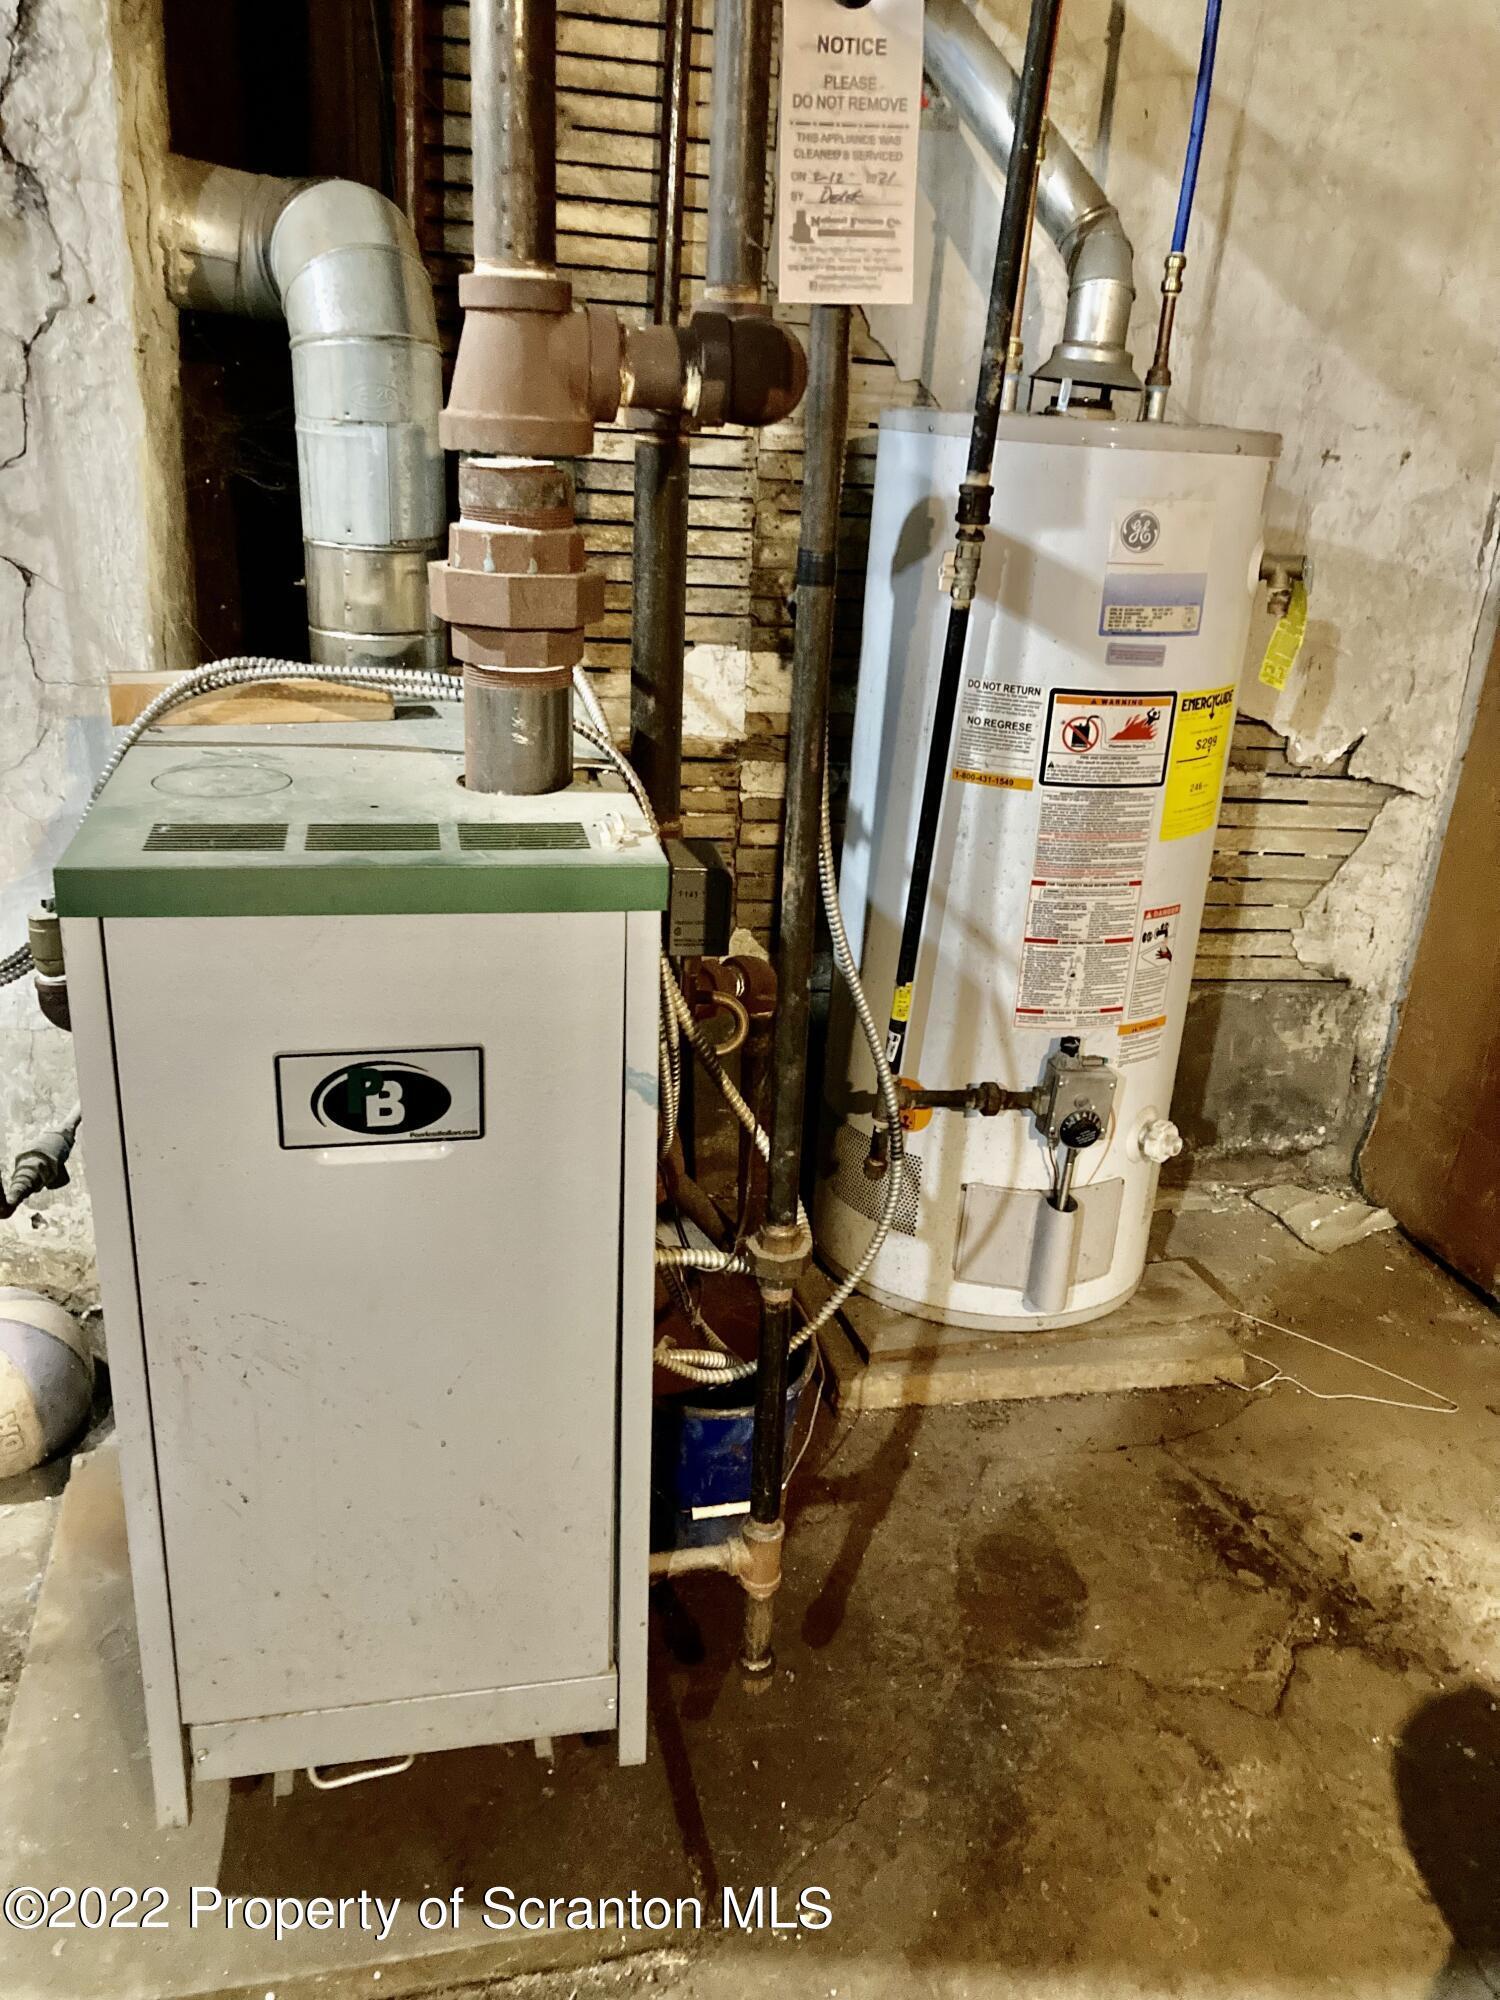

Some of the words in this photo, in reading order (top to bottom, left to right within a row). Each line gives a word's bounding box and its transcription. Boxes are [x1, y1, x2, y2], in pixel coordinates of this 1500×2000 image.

[817, 35, 887, 56] NOTICE
[823, 74, 878, 91] PLEASE
[792, 94, 813, 109] DO
[816, 95, 845, 110] NOT
[848, 96, 908, 112] REMOVE
[797, 132, 819, 143] THIS
[967, 679, 981, 689] DO
[983, 681, 1002, 692] NOT
[1003, 683, 1042, 696] RETURN
[1101, 698, 1143, 706] WARNING
[966, 715, 982, 726] NO
[983, 718, 1033, 733] REGRESE
[1195, 735, 1218, 751] $299
[347, 1067, 406, 1128] PB
